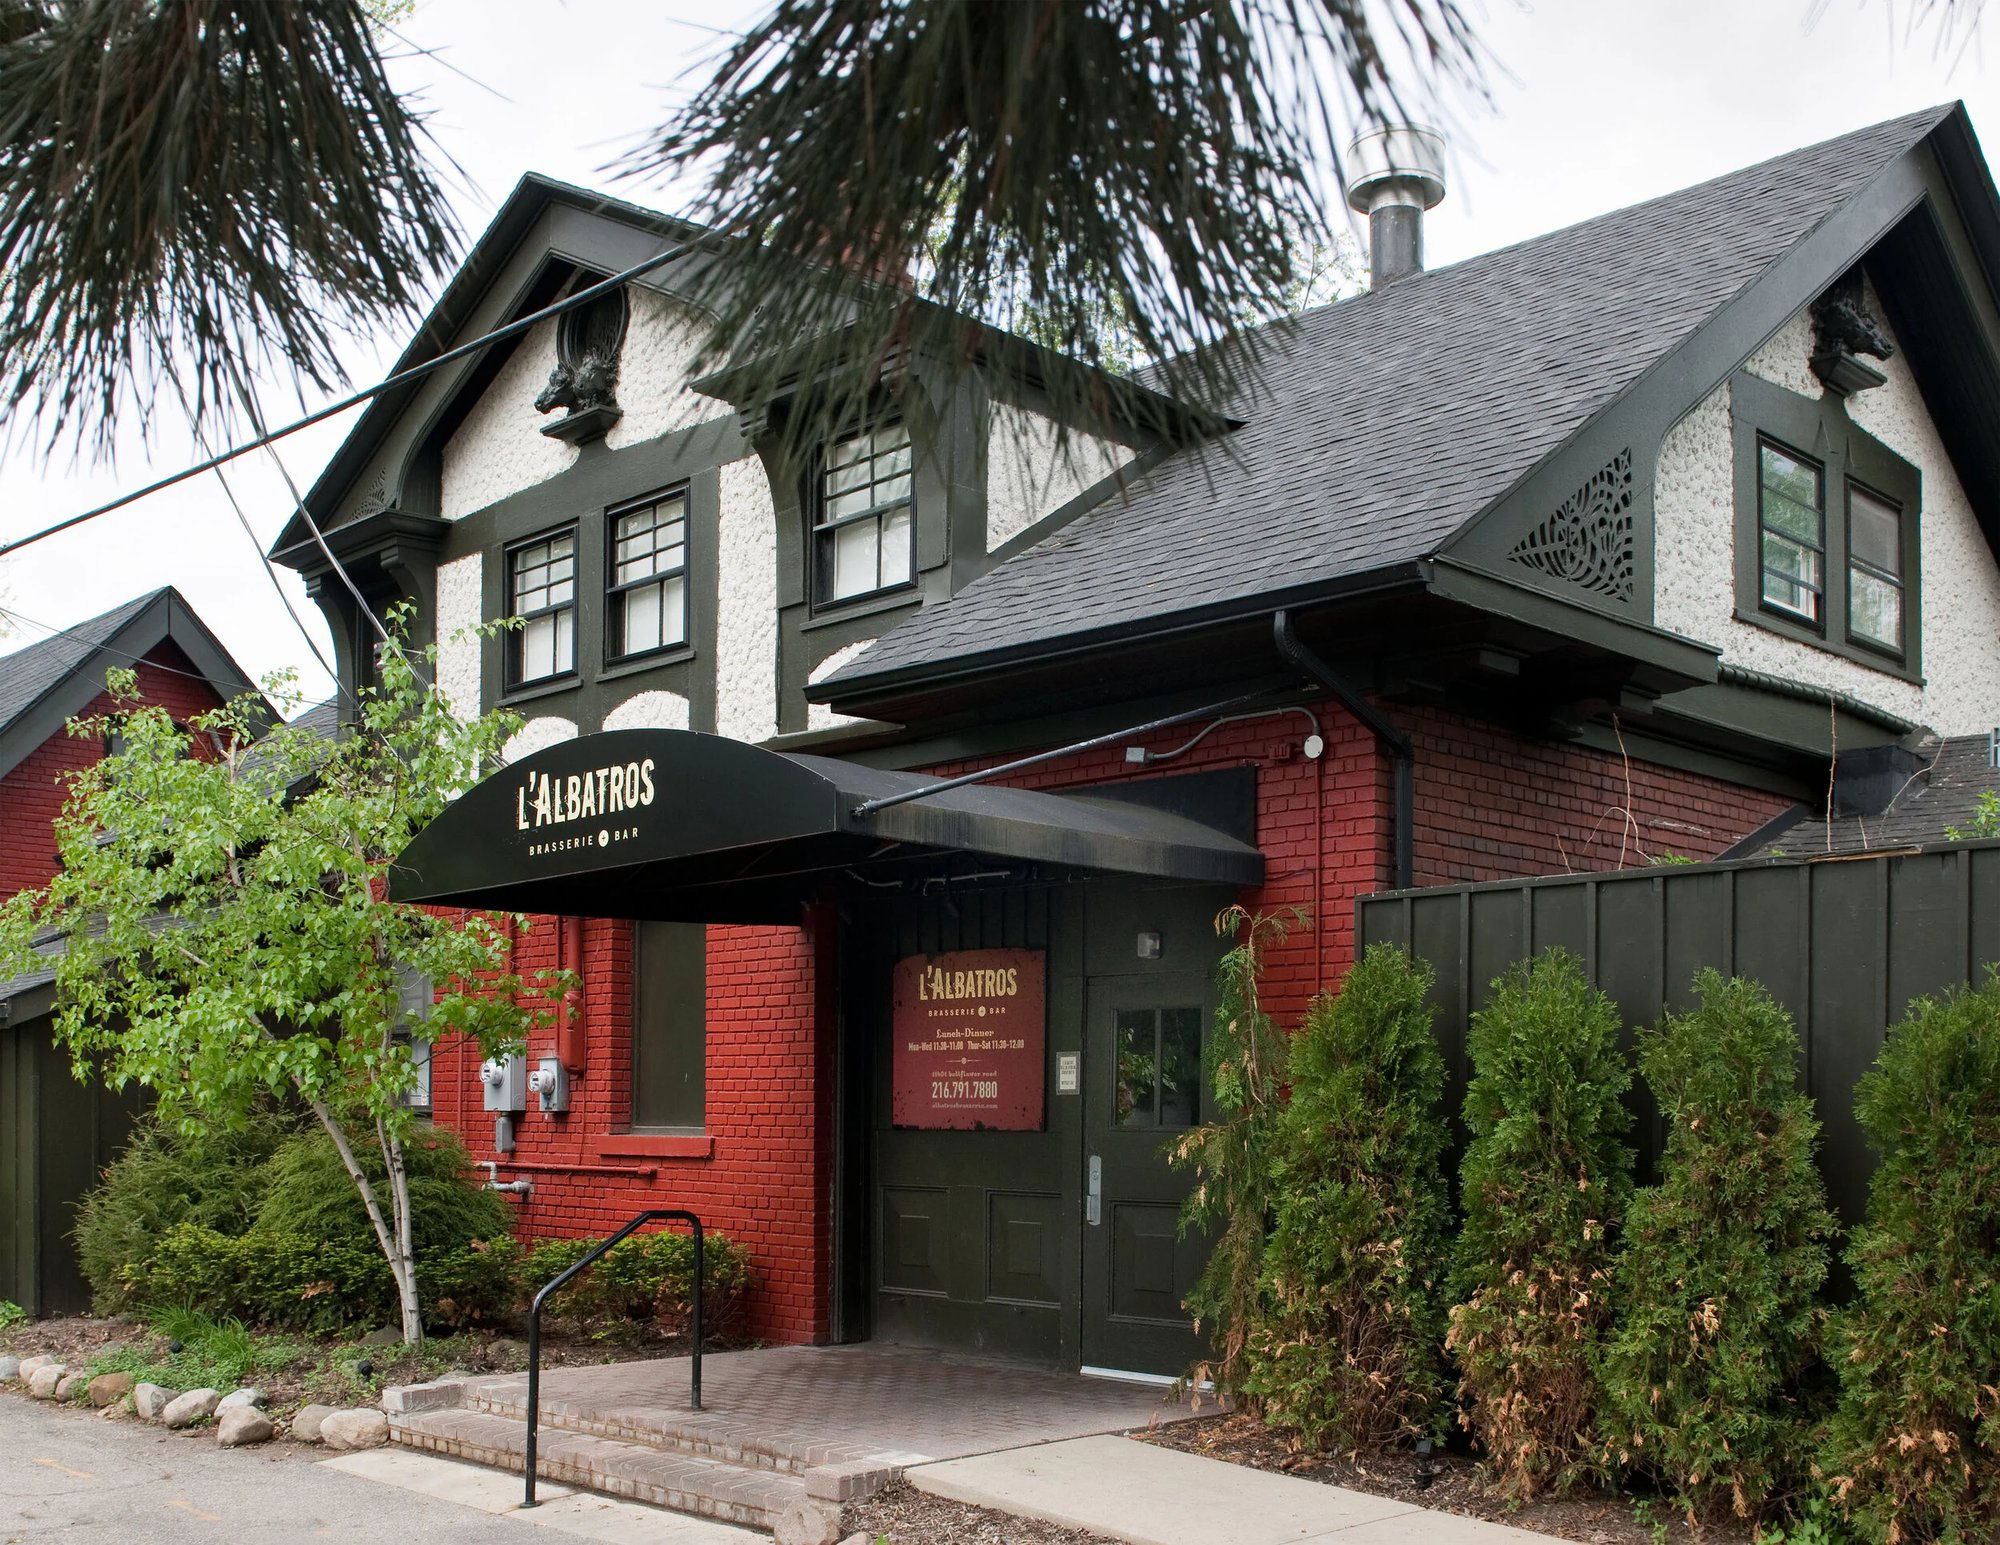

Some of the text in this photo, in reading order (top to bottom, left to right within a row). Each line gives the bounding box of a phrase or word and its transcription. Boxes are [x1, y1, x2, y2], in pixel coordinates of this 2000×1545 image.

[518, 758, 655, 830] L'ALBATROS
[529, 835, 593, 856] BRASSERIE
[614, 827, 638, 841] BAR
[919, 965, 1018, 1001] L'ALBATROS
[928, 1007, 1006, 1017] BRASSERIE BAR
[931, 1081, 998, 1099] 216.791.7880
